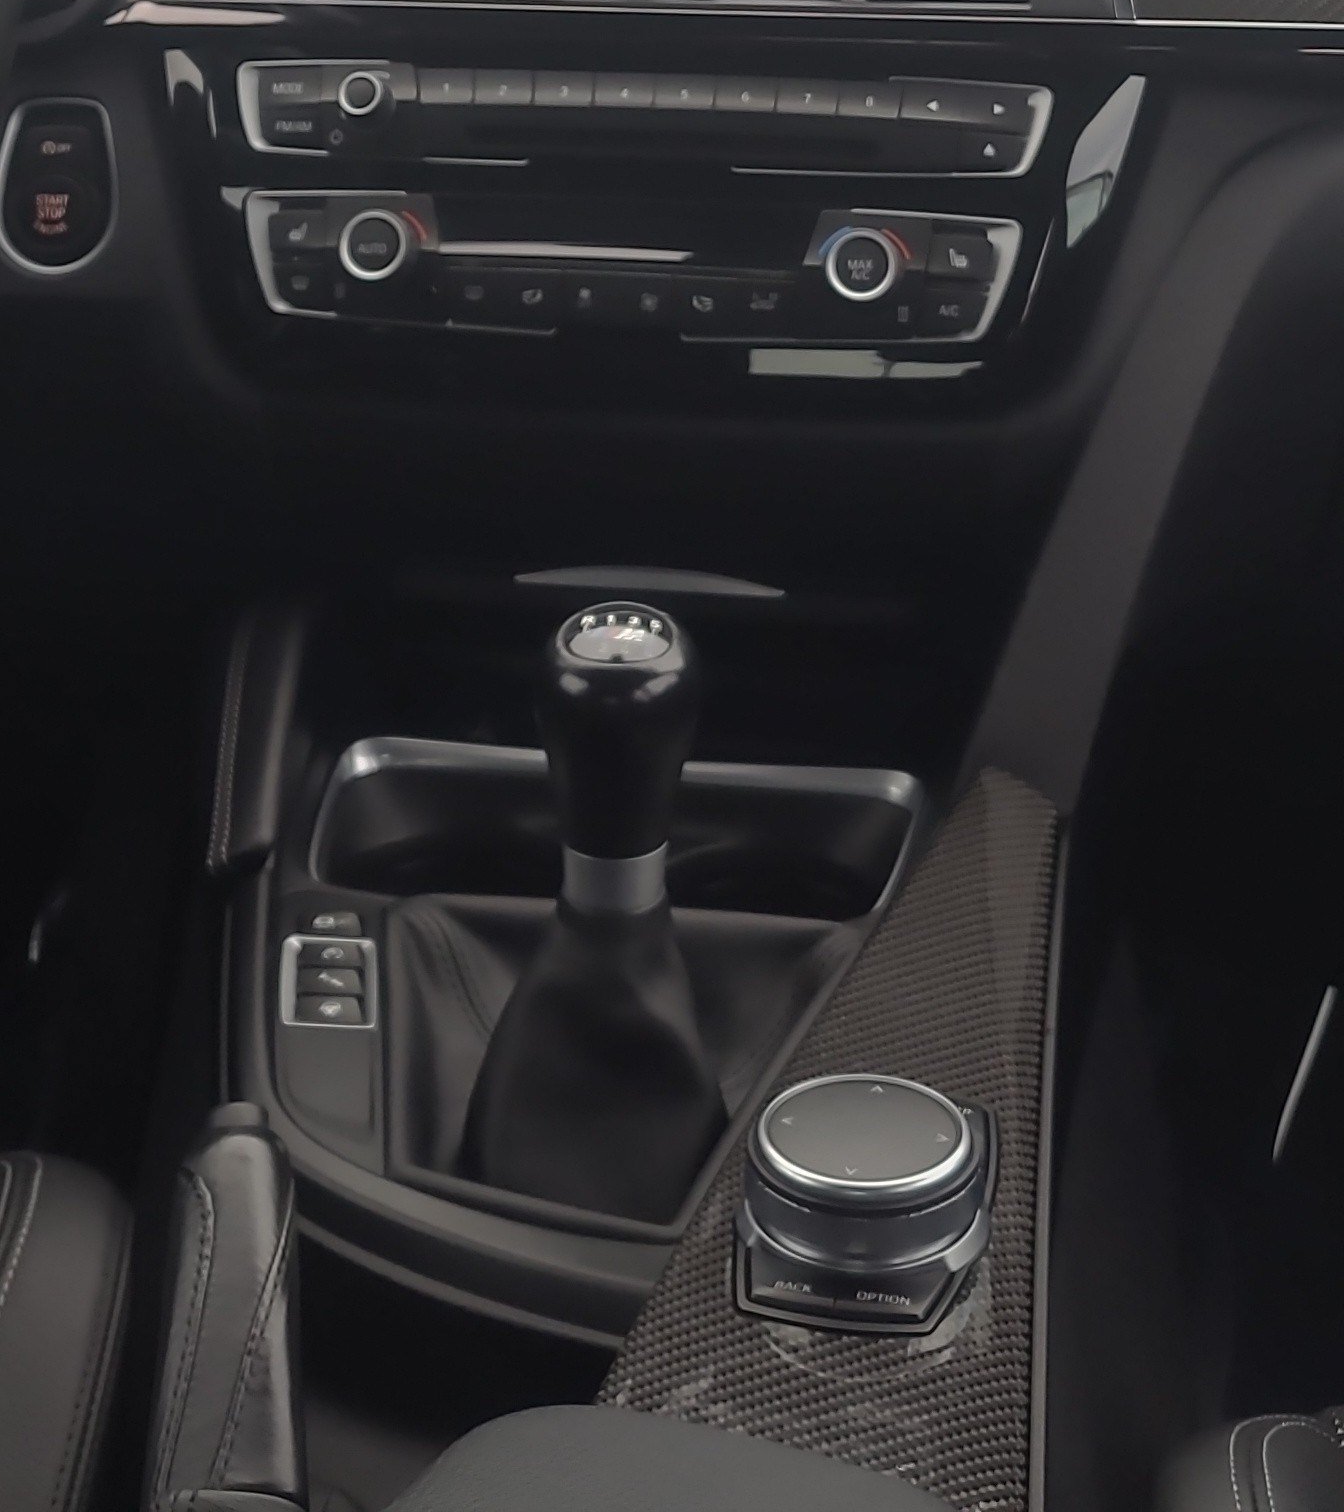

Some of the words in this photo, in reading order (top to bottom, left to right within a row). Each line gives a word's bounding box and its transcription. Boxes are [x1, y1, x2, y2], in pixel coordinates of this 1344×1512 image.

[559, 85, 569, 97] 3
[619, 86, 630, 99] 4
[802, 92, 812, 105] 7
[36, 193, 70, 207] START
[37, 207, 66, 220] STOP
[357, 242, 387, 254] AUTO
[848, 259, 874, 270] MAX
[938, 304, 959, 317] A/C
[773, 1280, 812, 1293] BACK
[855, 1291, 912, 1307] OPTION
